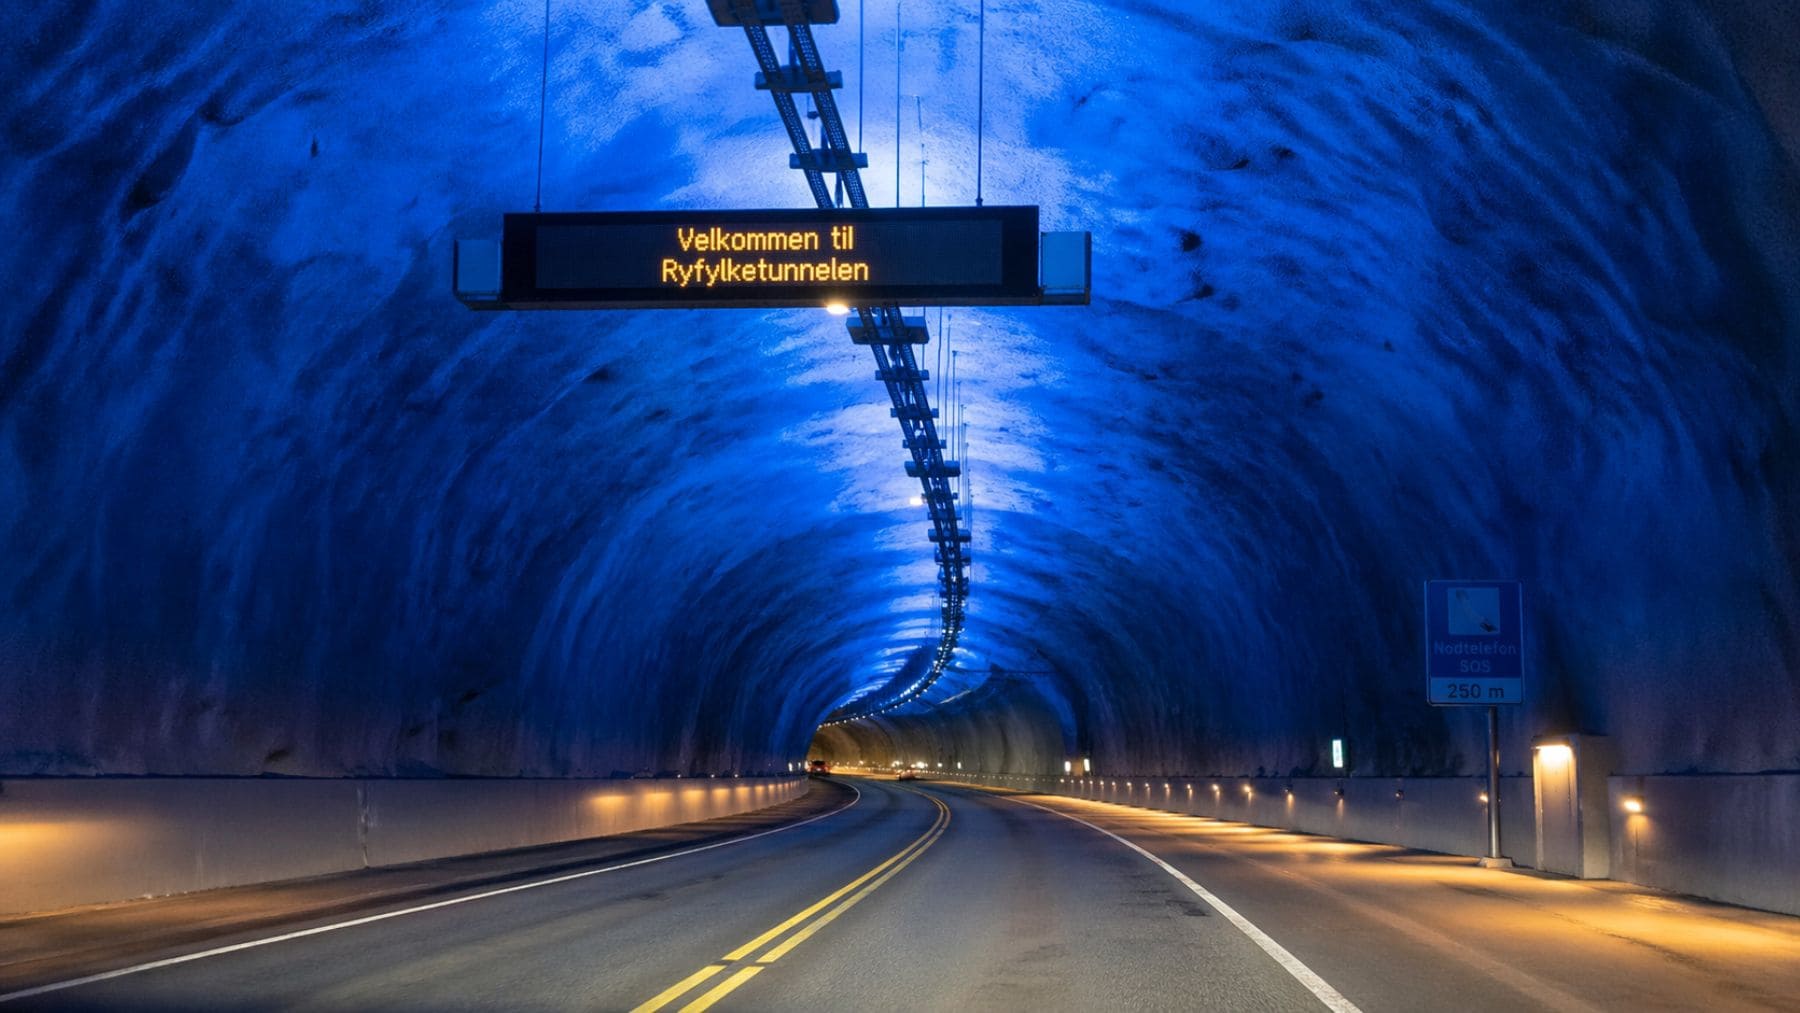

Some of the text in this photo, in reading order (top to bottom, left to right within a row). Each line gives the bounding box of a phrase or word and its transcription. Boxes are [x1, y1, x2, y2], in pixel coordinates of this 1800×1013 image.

[677, 225, 854, 252] Velkommen til
[661, 257, 869, 287] Ryfylketunnelen
[1460, 660, 1490, 673] SOS
[1448, 684, 1504, 698] 250 m
